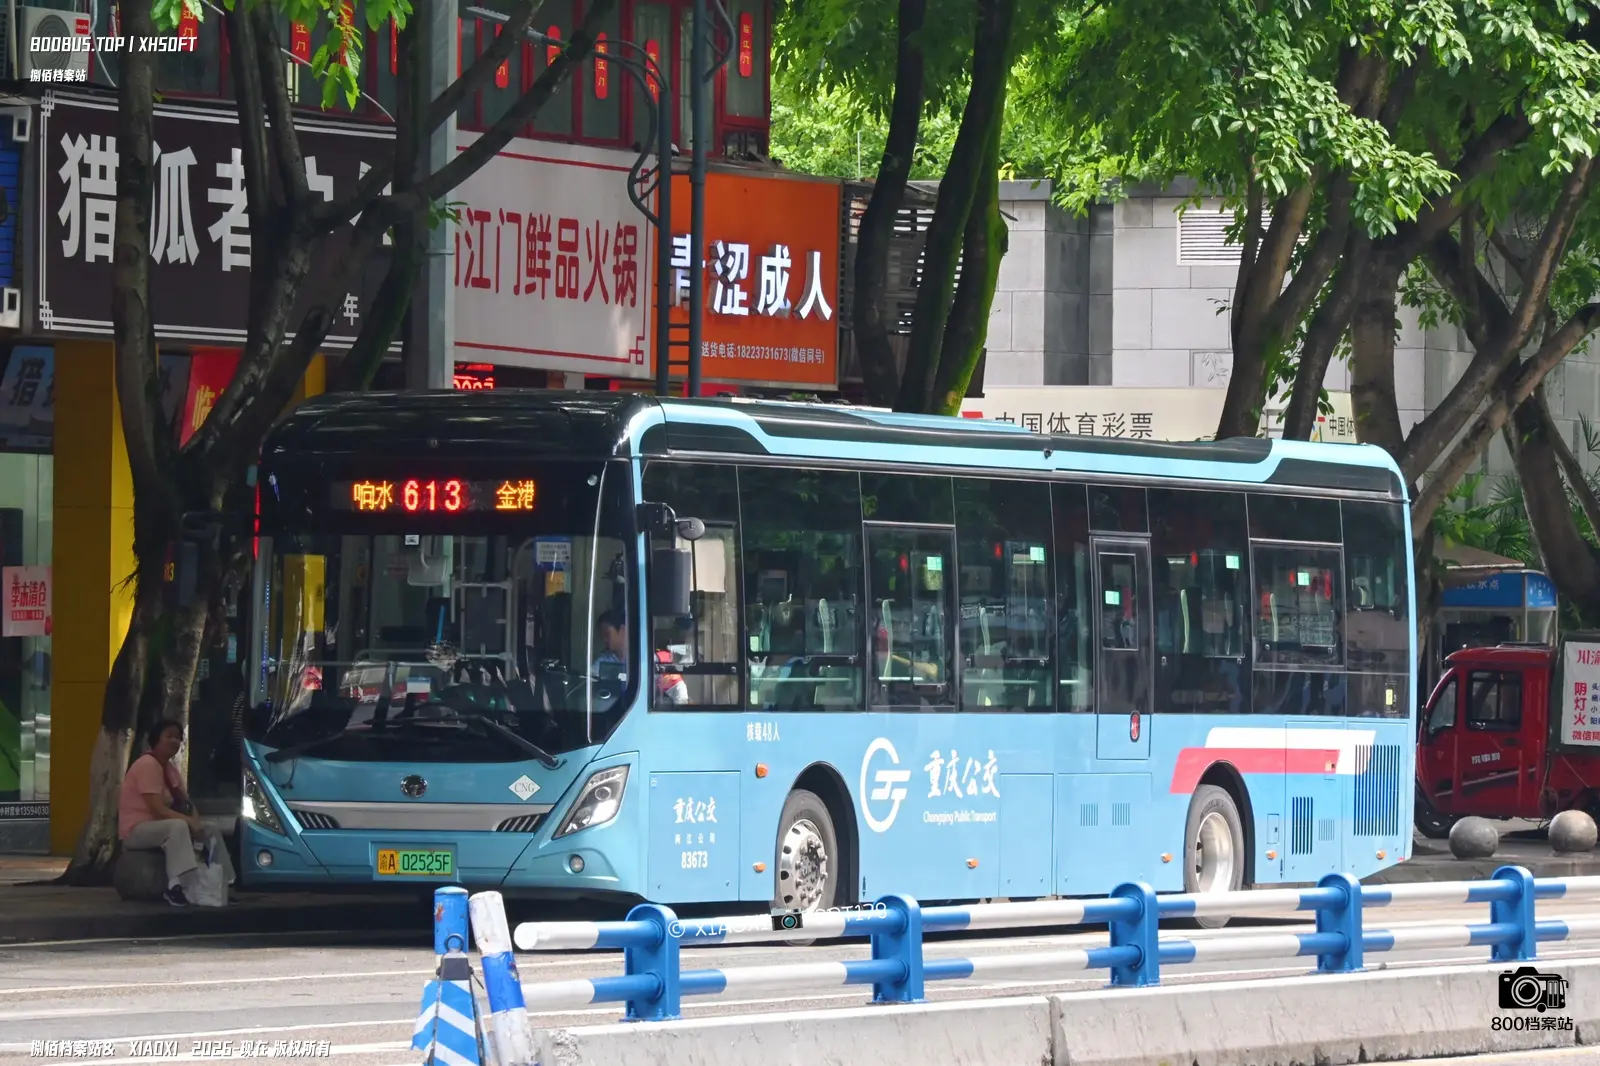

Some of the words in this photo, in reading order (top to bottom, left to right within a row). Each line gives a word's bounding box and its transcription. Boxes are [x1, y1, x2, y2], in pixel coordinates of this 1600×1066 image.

[454, 207, 637, 308] 江门鲜品火锅
[671, 234, 832, 320] 青涩成人
[995, 411, 1153, 439] 中国体育彩票
[353, 480, 393, 510] 响水
[404, 480, 461, 511] 613
[496, 480, 535, 509] 金港
[746, 722, 780, 741] 核载48人
[514, 782, 535, 793] CNG
[924, 749, 1001, 799] 重庆公交
[673, 797, 718, 823] 重庆公交
[681, 851, 708, 868] 83673
